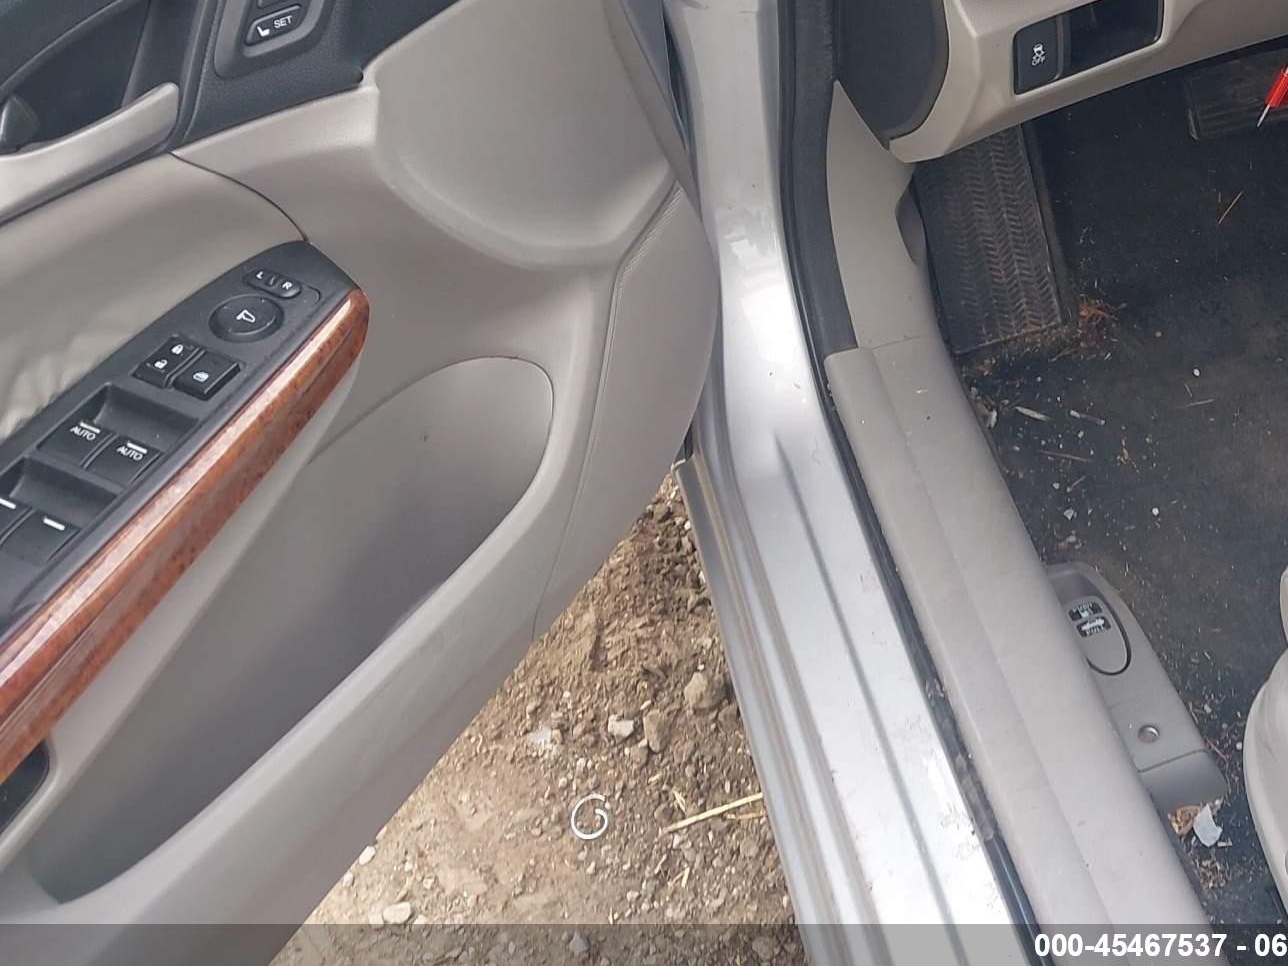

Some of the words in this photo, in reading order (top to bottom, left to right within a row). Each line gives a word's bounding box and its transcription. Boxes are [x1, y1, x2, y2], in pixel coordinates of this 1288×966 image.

[273, 14, 293, 29] SET
[1031, 56, 1046, 66] OFF
[256, 271, 264, 280] L
[281, 280, 293, 291] R
[69, 425, 97, 442] AUTO
[115, 445, 143, 462] AUTO
